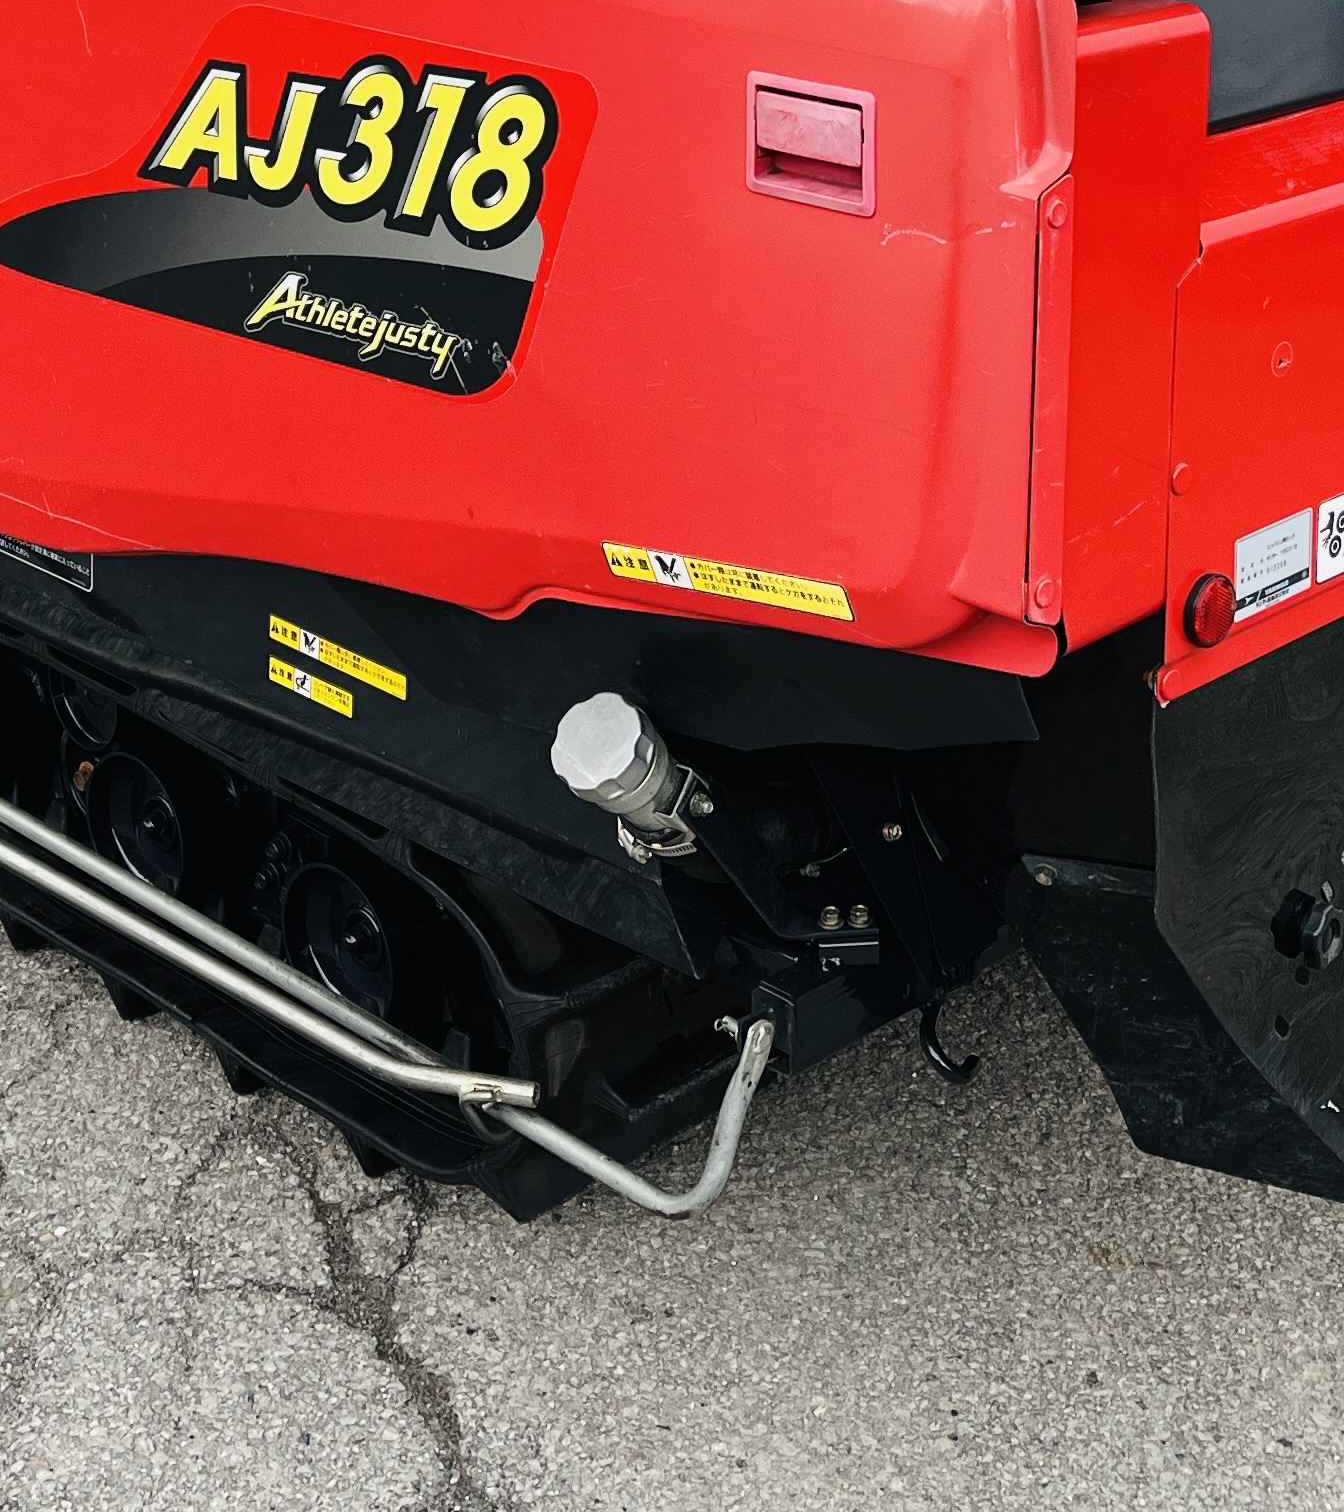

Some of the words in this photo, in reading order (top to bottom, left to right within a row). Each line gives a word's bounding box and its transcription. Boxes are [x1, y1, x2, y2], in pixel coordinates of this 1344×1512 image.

[143, 59, 553, 239] AJ318
[245, 271, 463, 380] Athletejusty
[622, 554, 650, 572] 注意
